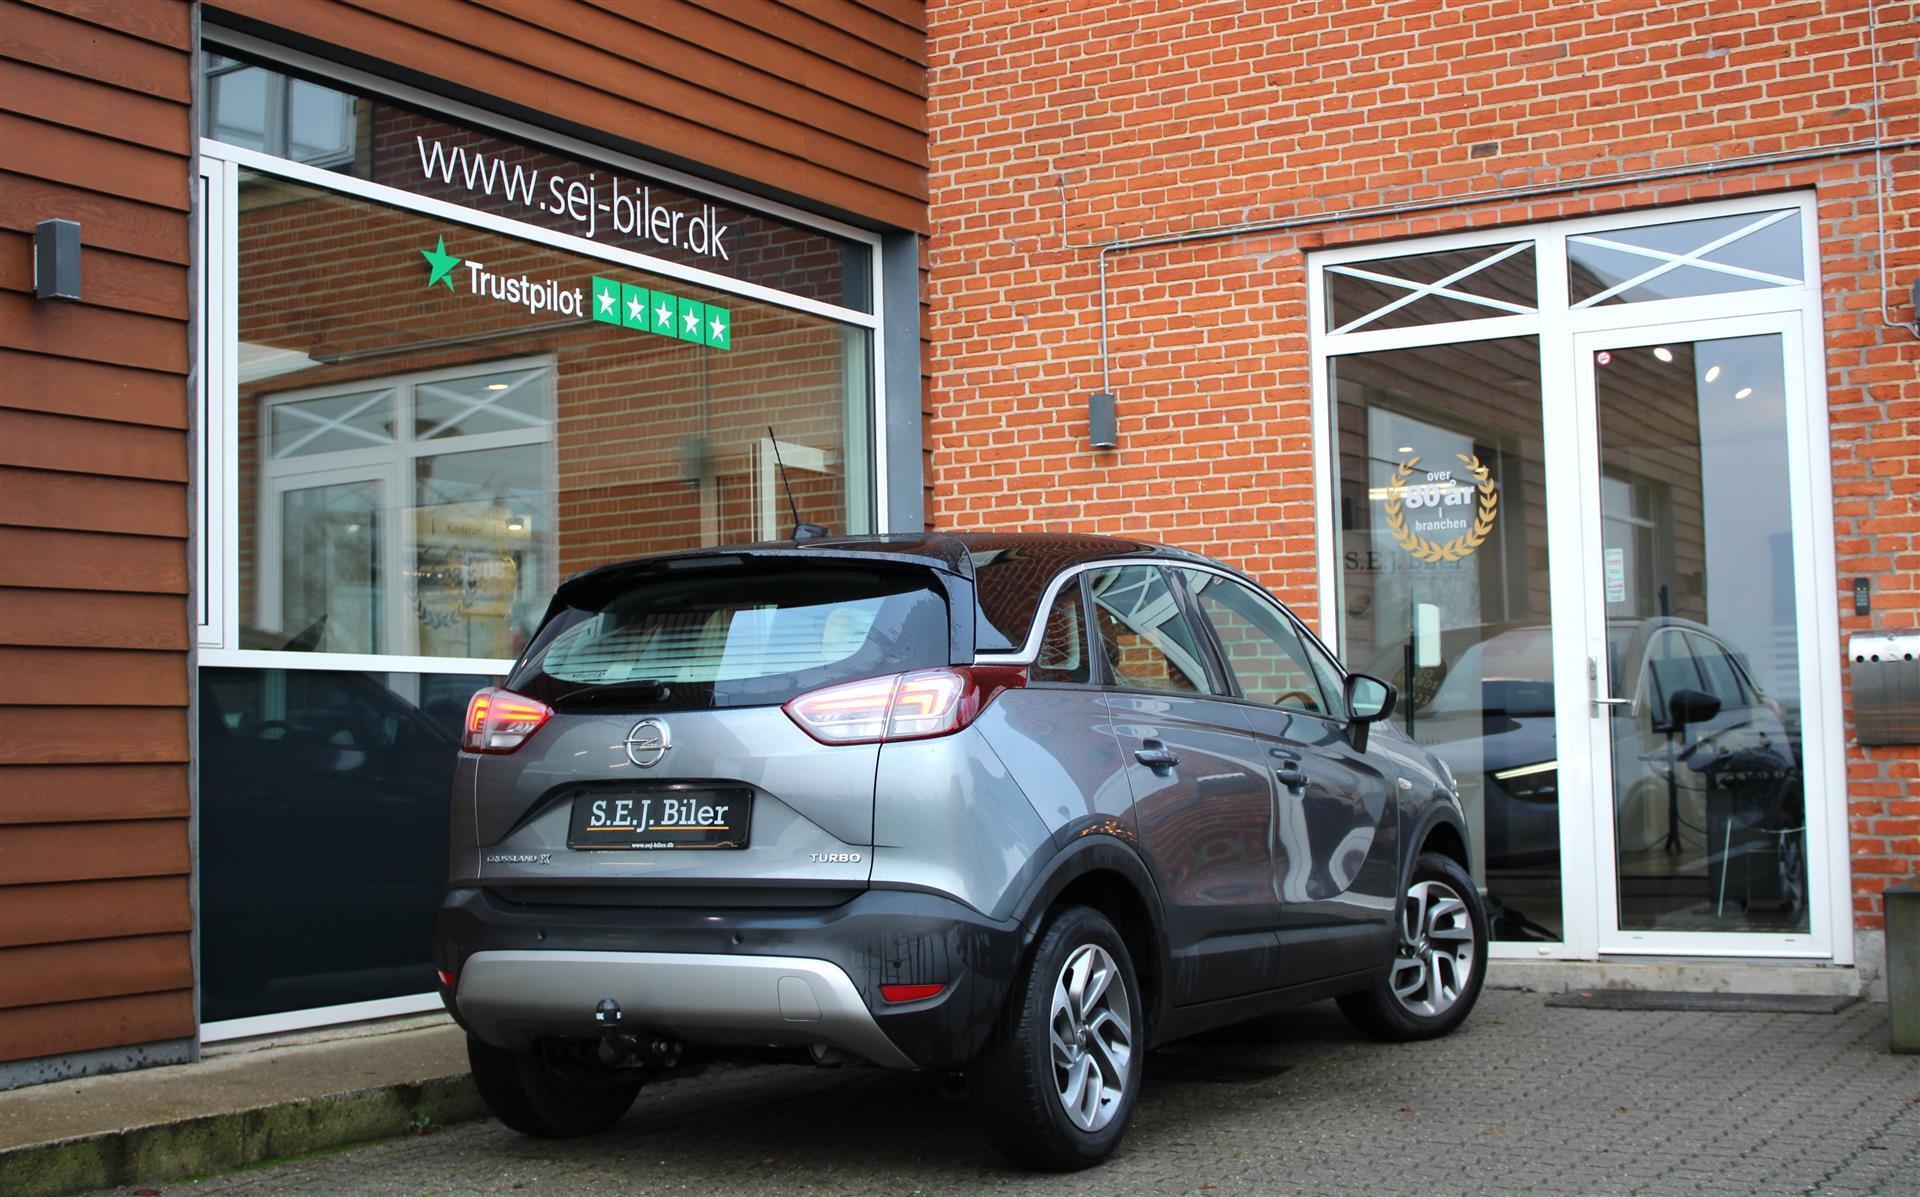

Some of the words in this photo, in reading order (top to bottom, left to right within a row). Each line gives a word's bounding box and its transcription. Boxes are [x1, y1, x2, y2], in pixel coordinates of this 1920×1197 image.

[417, 135, 729, 261] www.sej-biler.dk
[465, 260, 584, 317] Trustpilot
[1427, 471, 1451, 481] over
[1406, 484, 1440, 508] 80
[1444, 479, 1475, 505] år
[1415, 519, 1467, 531] branchen
[590, 799, 654, 833] S.E.J.
[661, 798, 728, 825] Biler
[540, 853, 552, 864] X
[809, 853, 861, 863] TURBO
